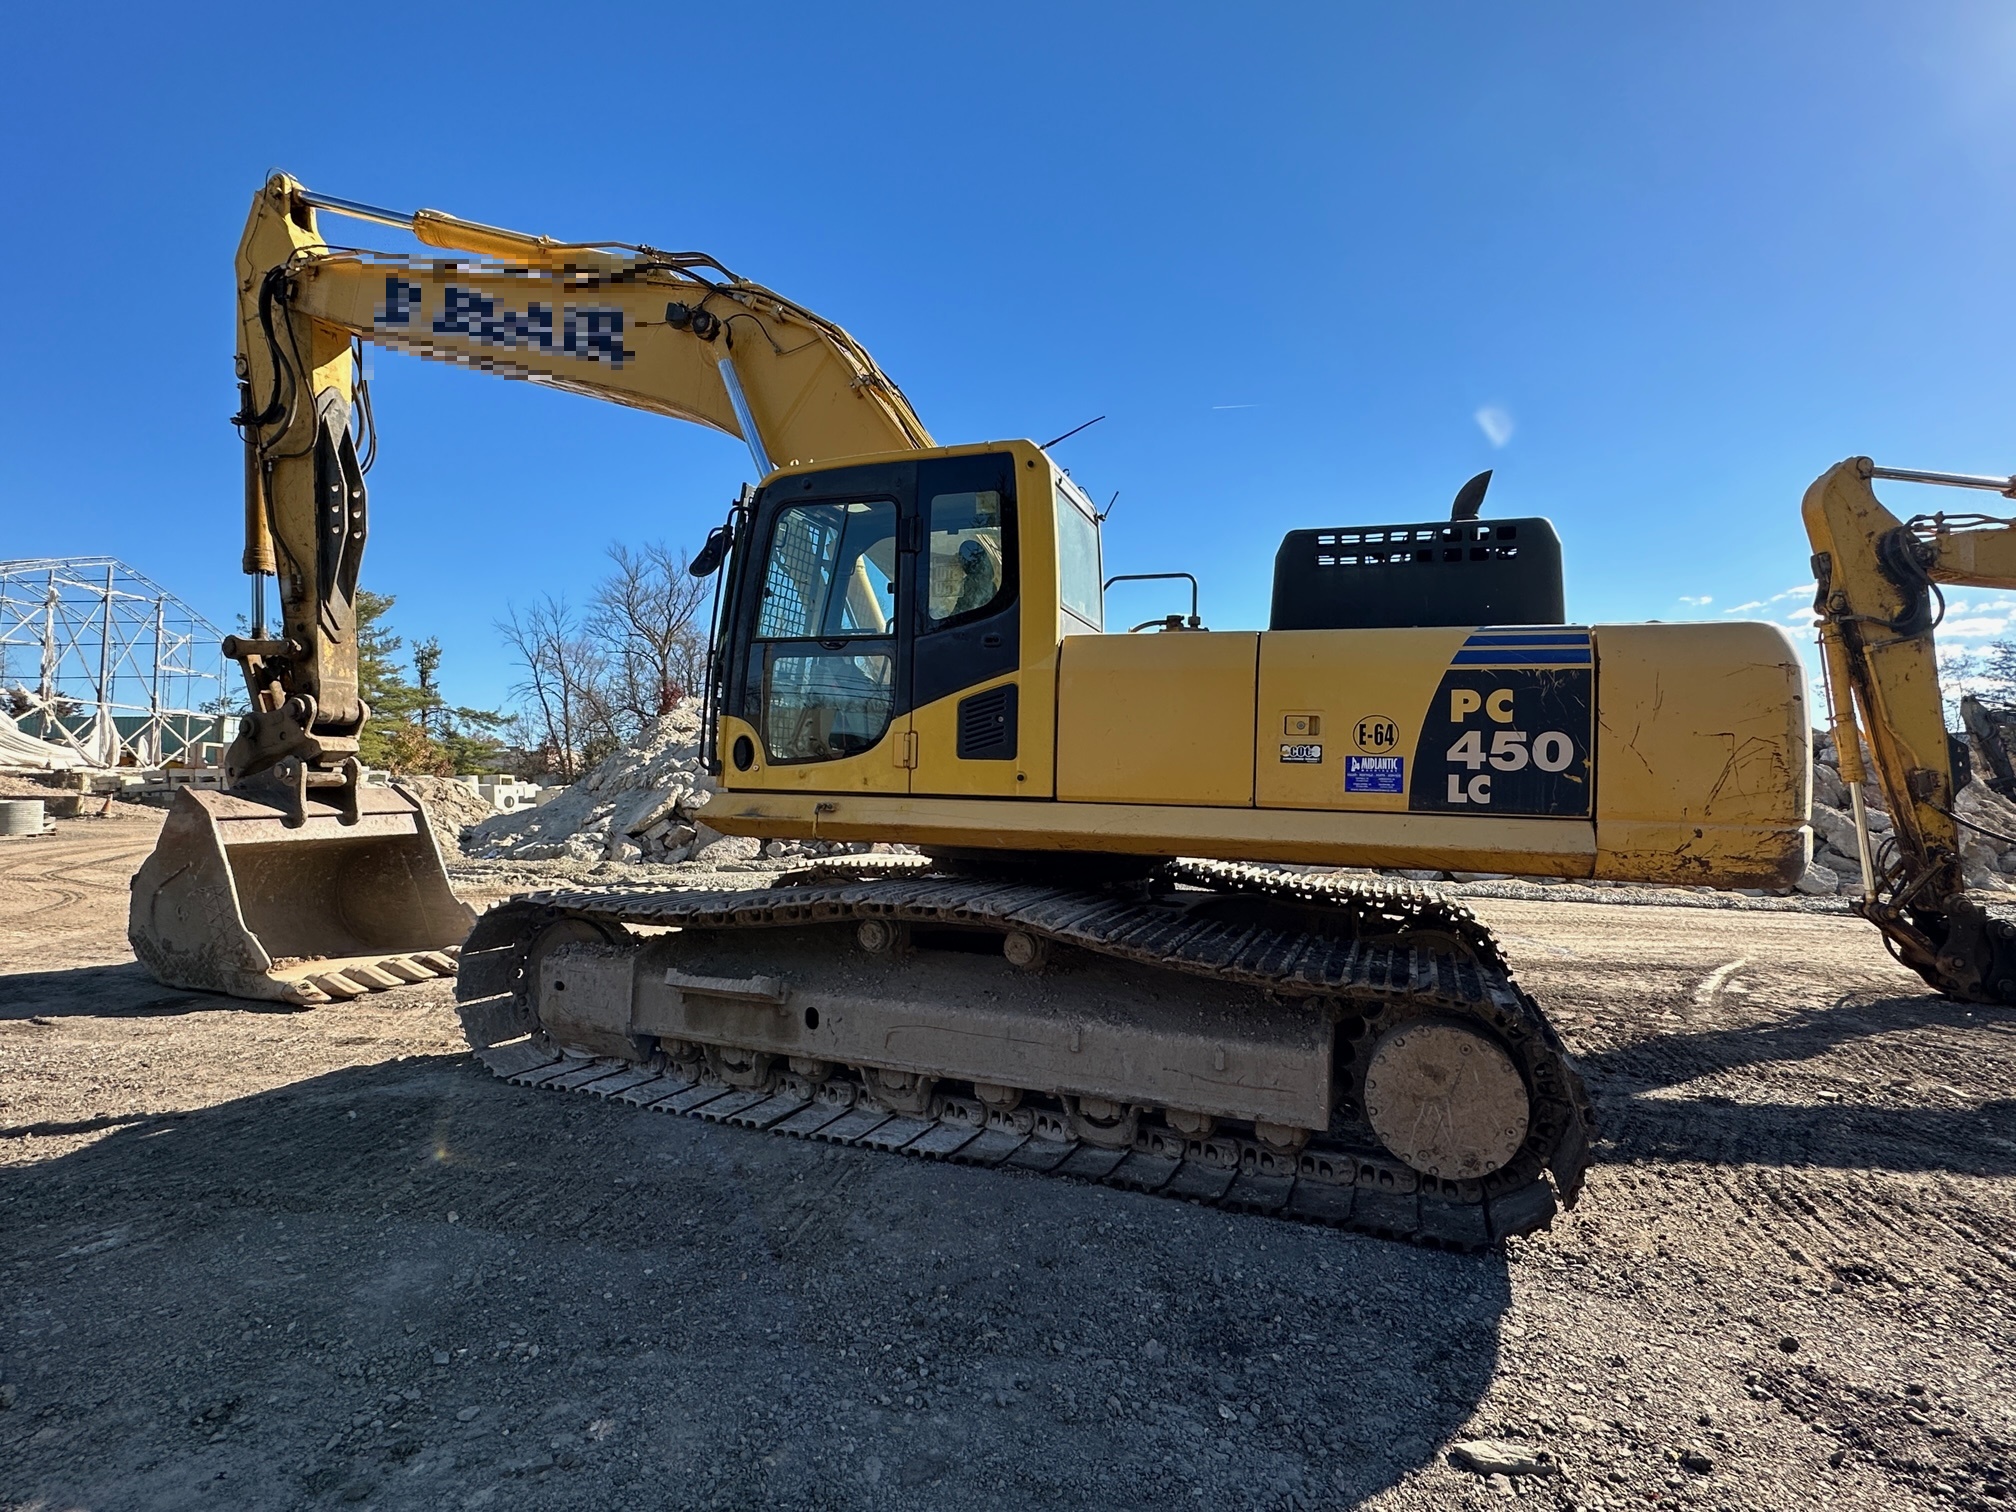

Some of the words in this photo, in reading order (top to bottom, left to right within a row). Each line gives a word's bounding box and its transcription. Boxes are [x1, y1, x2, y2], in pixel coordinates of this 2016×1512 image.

[1450, 688, 1514, 724] PC
[1359, 724, 1394, 746] E-64
[1361, 757, 1398, 770] MIDLANTIC
[1446, 731, 1574, 772] 450
[1447, 774, 1491, 804] LC
